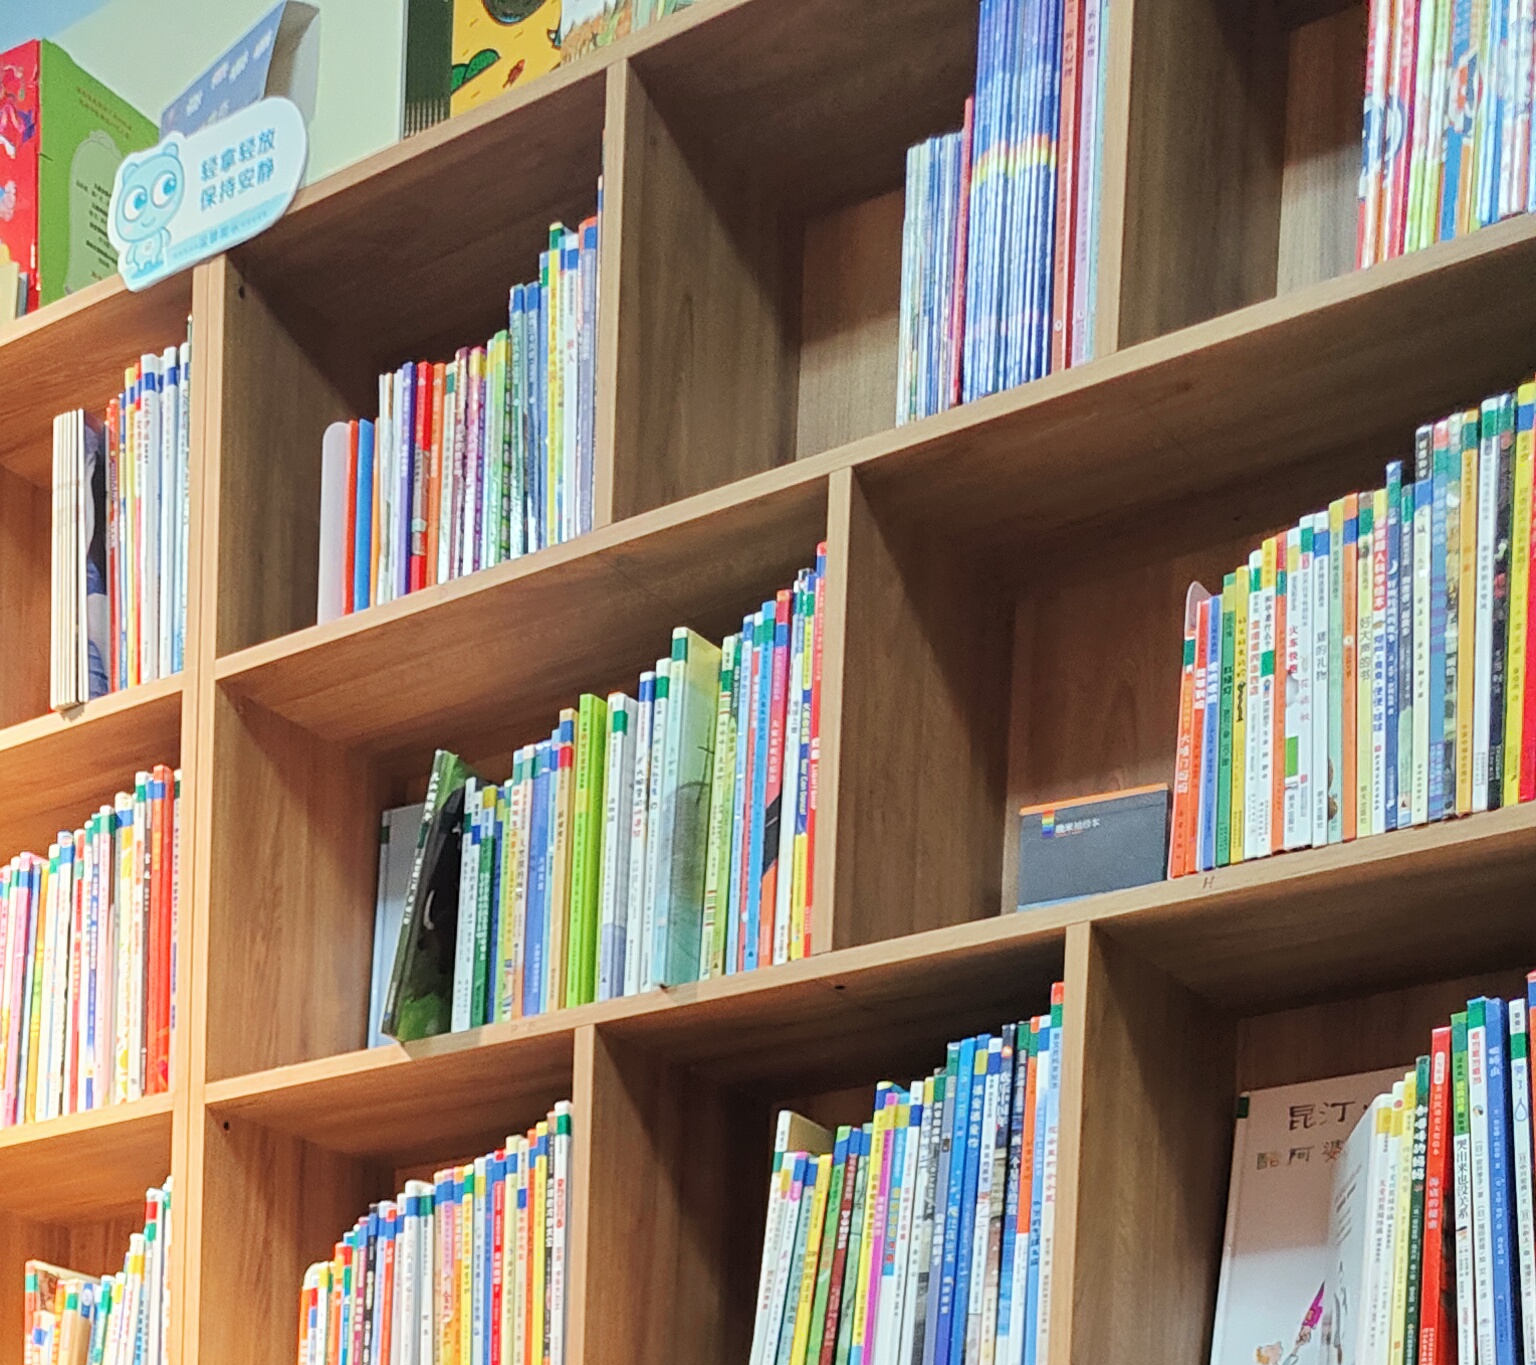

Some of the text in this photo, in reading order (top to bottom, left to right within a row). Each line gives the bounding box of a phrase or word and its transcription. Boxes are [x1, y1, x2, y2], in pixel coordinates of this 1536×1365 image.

[200, 127, 276, 182] 轻拿轻放
[200, 157, 275, 212] 保持安静
